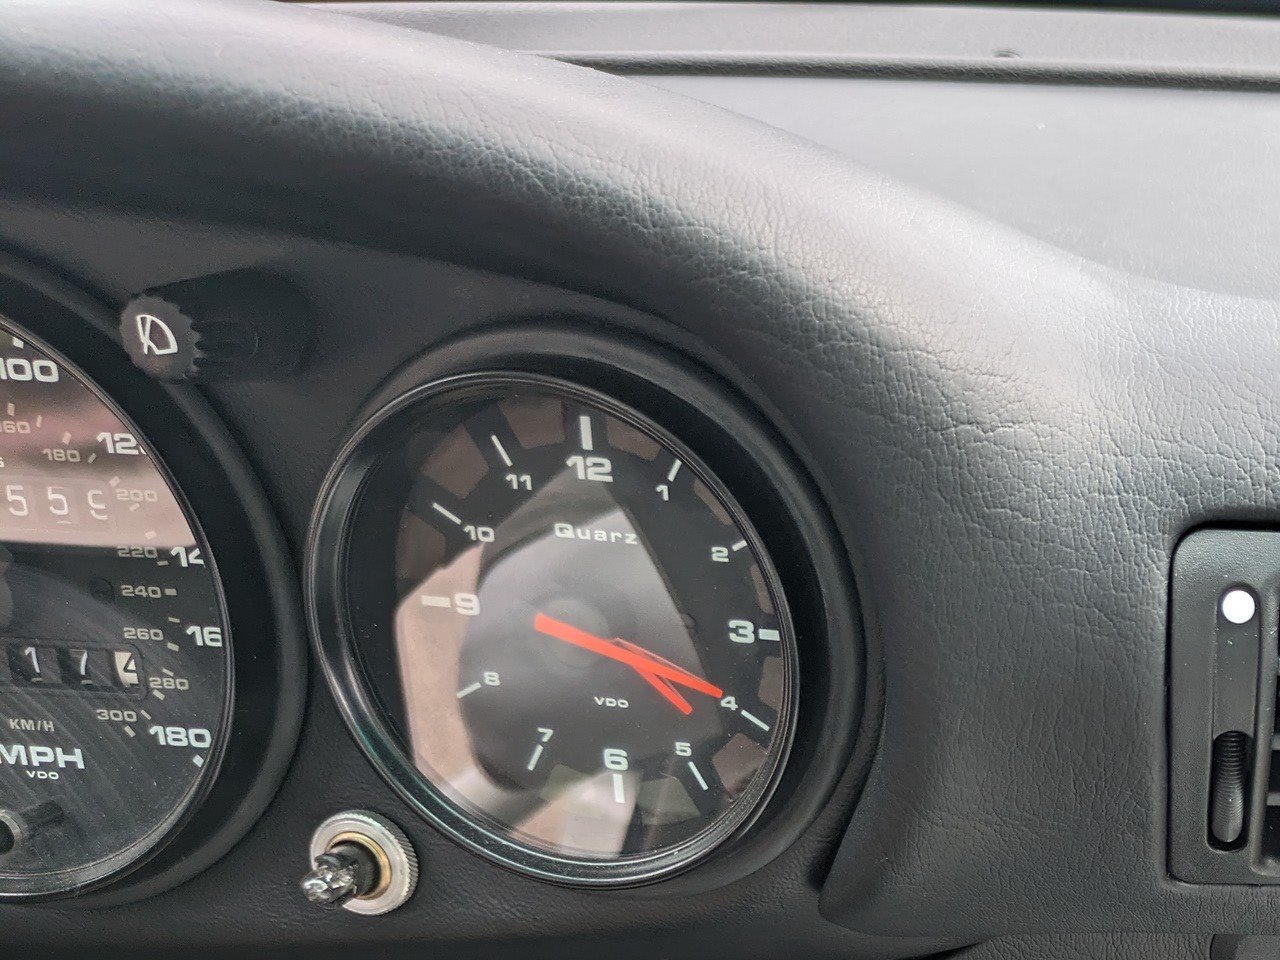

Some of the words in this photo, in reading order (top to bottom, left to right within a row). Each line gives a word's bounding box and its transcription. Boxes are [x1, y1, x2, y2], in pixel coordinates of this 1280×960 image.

[0, 420, 31, 434] 60
[97, 431, 147, 456] 12
[43, 448, 81, 462] 180
[565, 456, 614, 483] 12
[505, 474, 532, 491] 11
[115, 489, 158, 502] 200
[656, 484, 670, 501] 1
[463, 524, 496, 543] 10
[553, 523, 639, 546] Quarz
[117, 546, 158, 559] 220
[711, 546, 730, 563] 2
[120, 585, 162, 598] 240
[453, 592, 481, 616] 9
[123, 627, 164, 641] 260
[728, 620, 756, 644] 3
[149, 677, 189, 690] 280
[482, 671, 501, 687] 8
[593, 696, 630, 709] VDO
[719, 696, 739, 711] 4
[96, 709, 137, 722] 300
[9, 718, 55, 732] KM/H
[149, 725, 212, 748] 180
[537, 728, 554, 743] 7
[0, 744, 85, 770] MPH
[675, 742, 692, 757] 5
[603, 748, 629, 771] 6
[26, 770, 59, 780] VDO
